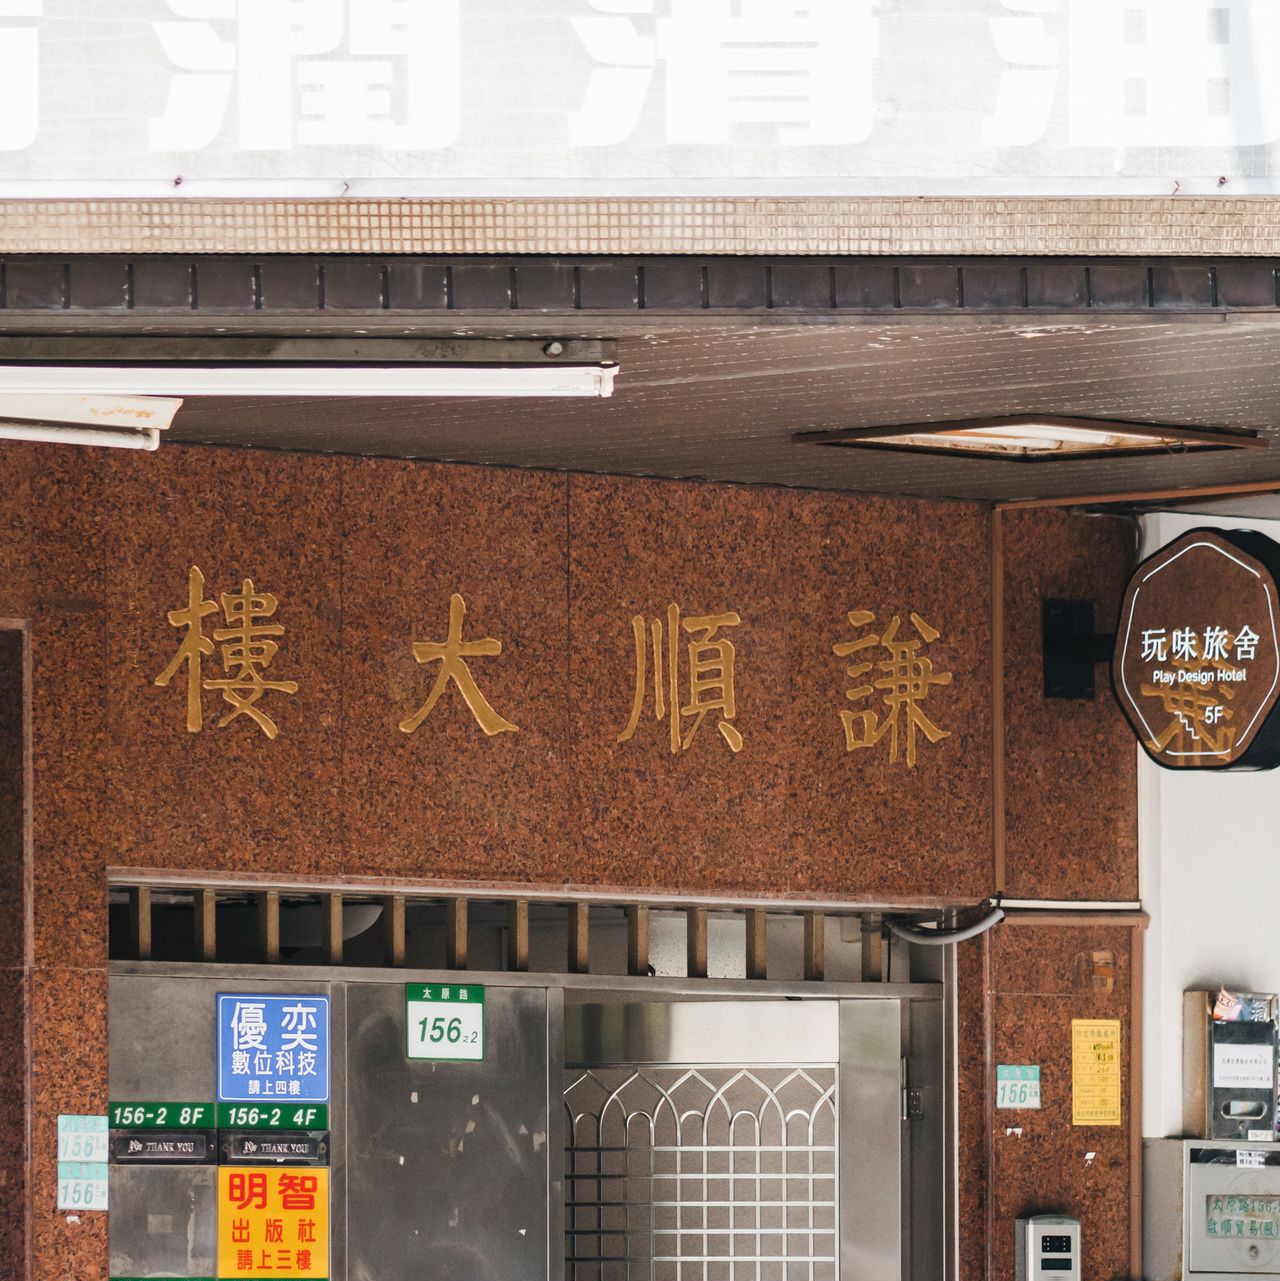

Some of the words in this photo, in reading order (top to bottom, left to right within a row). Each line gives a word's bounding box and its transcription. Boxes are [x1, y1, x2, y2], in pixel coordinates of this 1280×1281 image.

[1140, 625, 1260, 662] 玩味旅舍
[1153, 670, 1176, 685] Play
[1178, 669, 1214, 684] Design
[1217, 668, 1246, 682] Hotel
[1204, 706, 1224, 724] 5F
[422, 988, 468, 1000] 太原路
[230, 1001, 318, 1051] 優奕
[231, 1050, 317, 1076] 數位科技
[248, 1079, 301, 1096] 請上四樓
[1000, 1083, 1028, 1104] 156
[114, 1107, 167, 1126] 156-2
[179, 1107, 205, 1126] 8F
[228, 1108, 281, 1126] 156-2
[293, 1108, 318, 1126] 4F
[146, 1141, 174, 1153] THANK
[175, 1140, 194, 1153] YOU
[261, 1142, 289, 1154] THANK
[291, 1142, 308, 1154] YOU
[61, 1182, 94, 1205] 156
[227, 1173, 319, 1211] 明智
[231, 1218, 317, 1244] 出版社
[236, 1249, 312, 1271] 請上三樓
